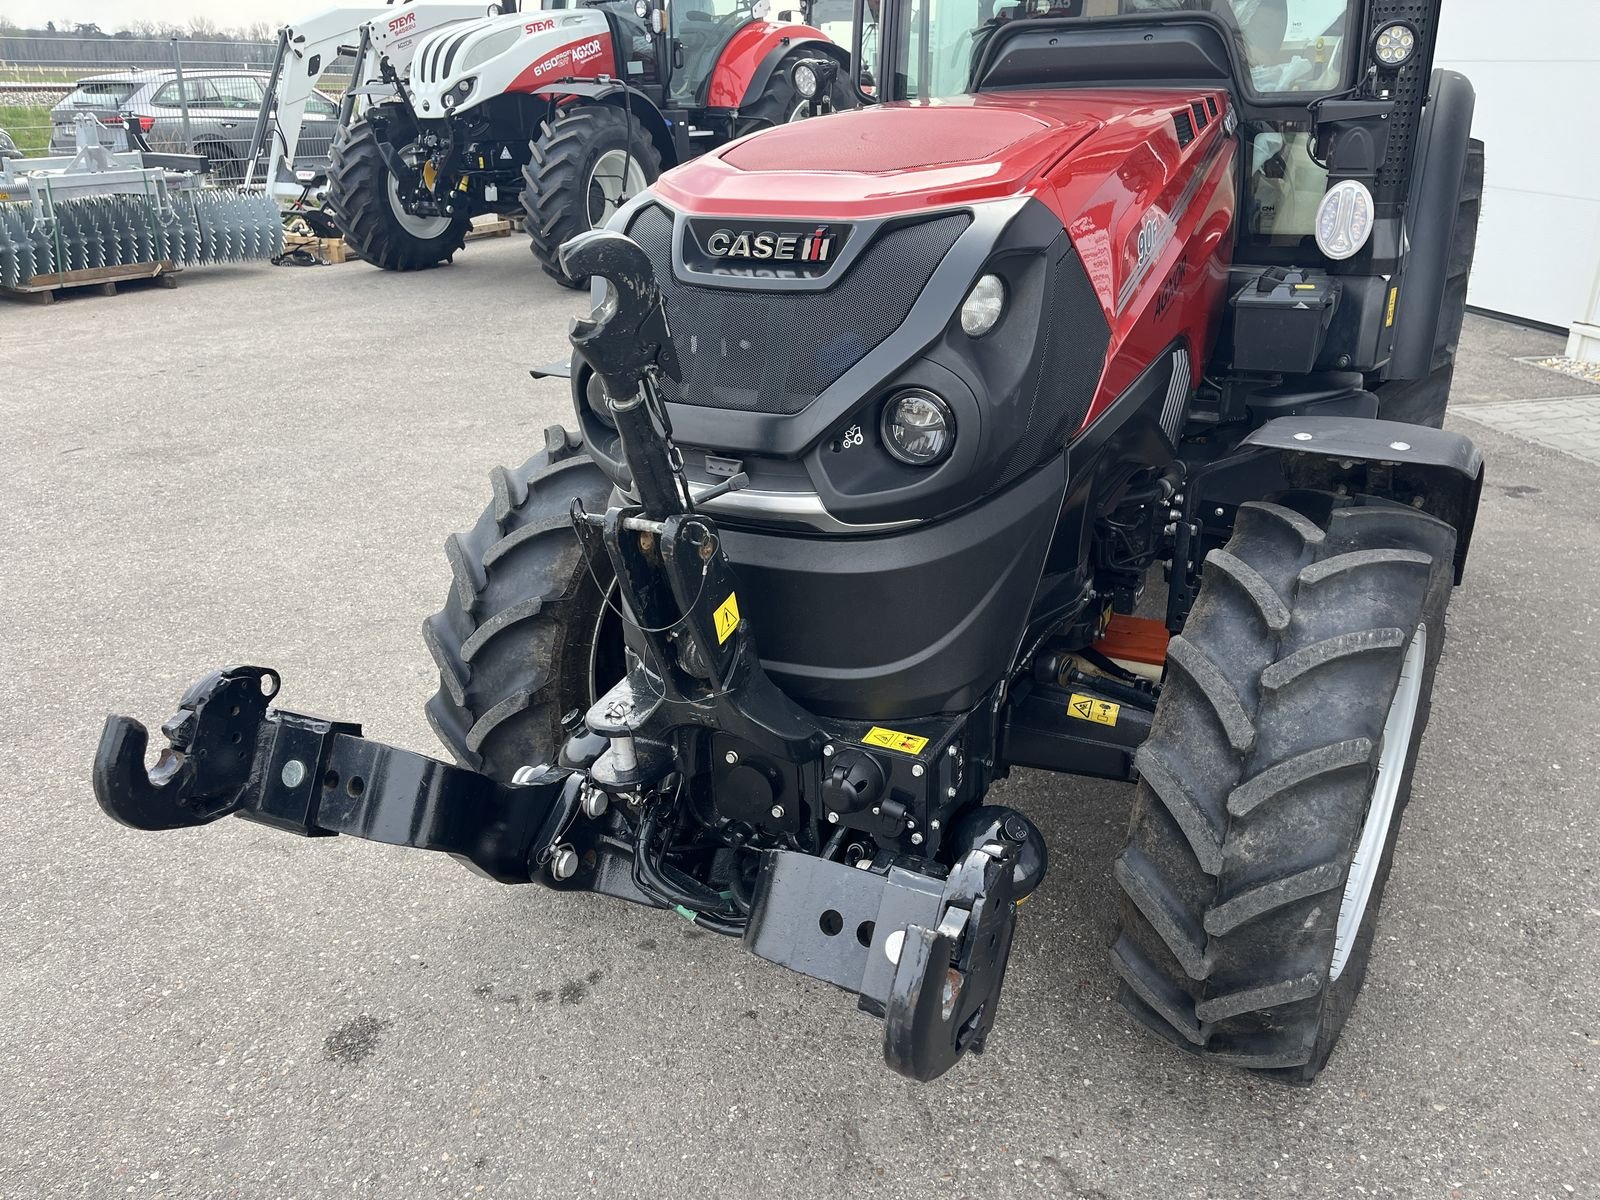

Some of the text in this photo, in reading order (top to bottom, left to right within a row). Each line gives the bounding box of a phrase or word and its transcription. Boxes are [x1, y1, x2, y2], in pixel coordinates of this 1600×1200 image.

[388, 12, 416, 32] STEYR
[525, 19, 555, 35] STEYR
[571, 39, 602, 62] AGXOR
[533, 57, 557, 77] 6150
[707, 229, 801, 260] CASE
